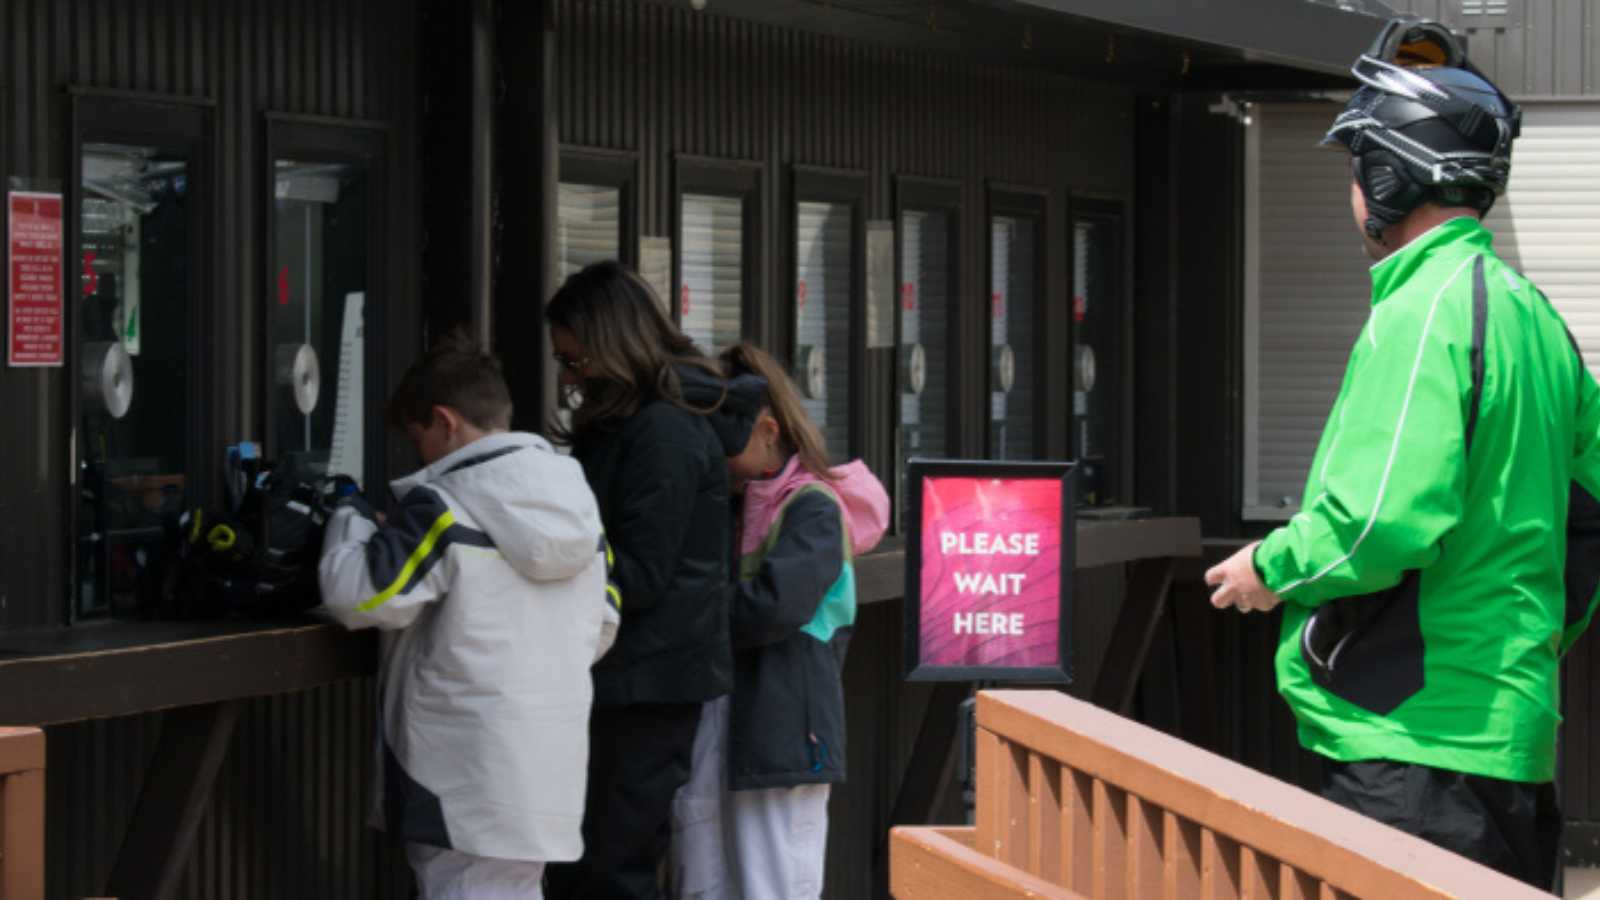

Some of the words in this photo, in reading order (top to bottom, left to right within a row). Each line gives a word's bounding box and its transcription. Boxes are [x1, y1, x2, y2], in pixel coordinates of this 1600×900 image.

[940, 532, 1040, 555] PLEASE
[953, 572, 1026, 595] WAIT
[954, 612, 1024, 635] HERE
